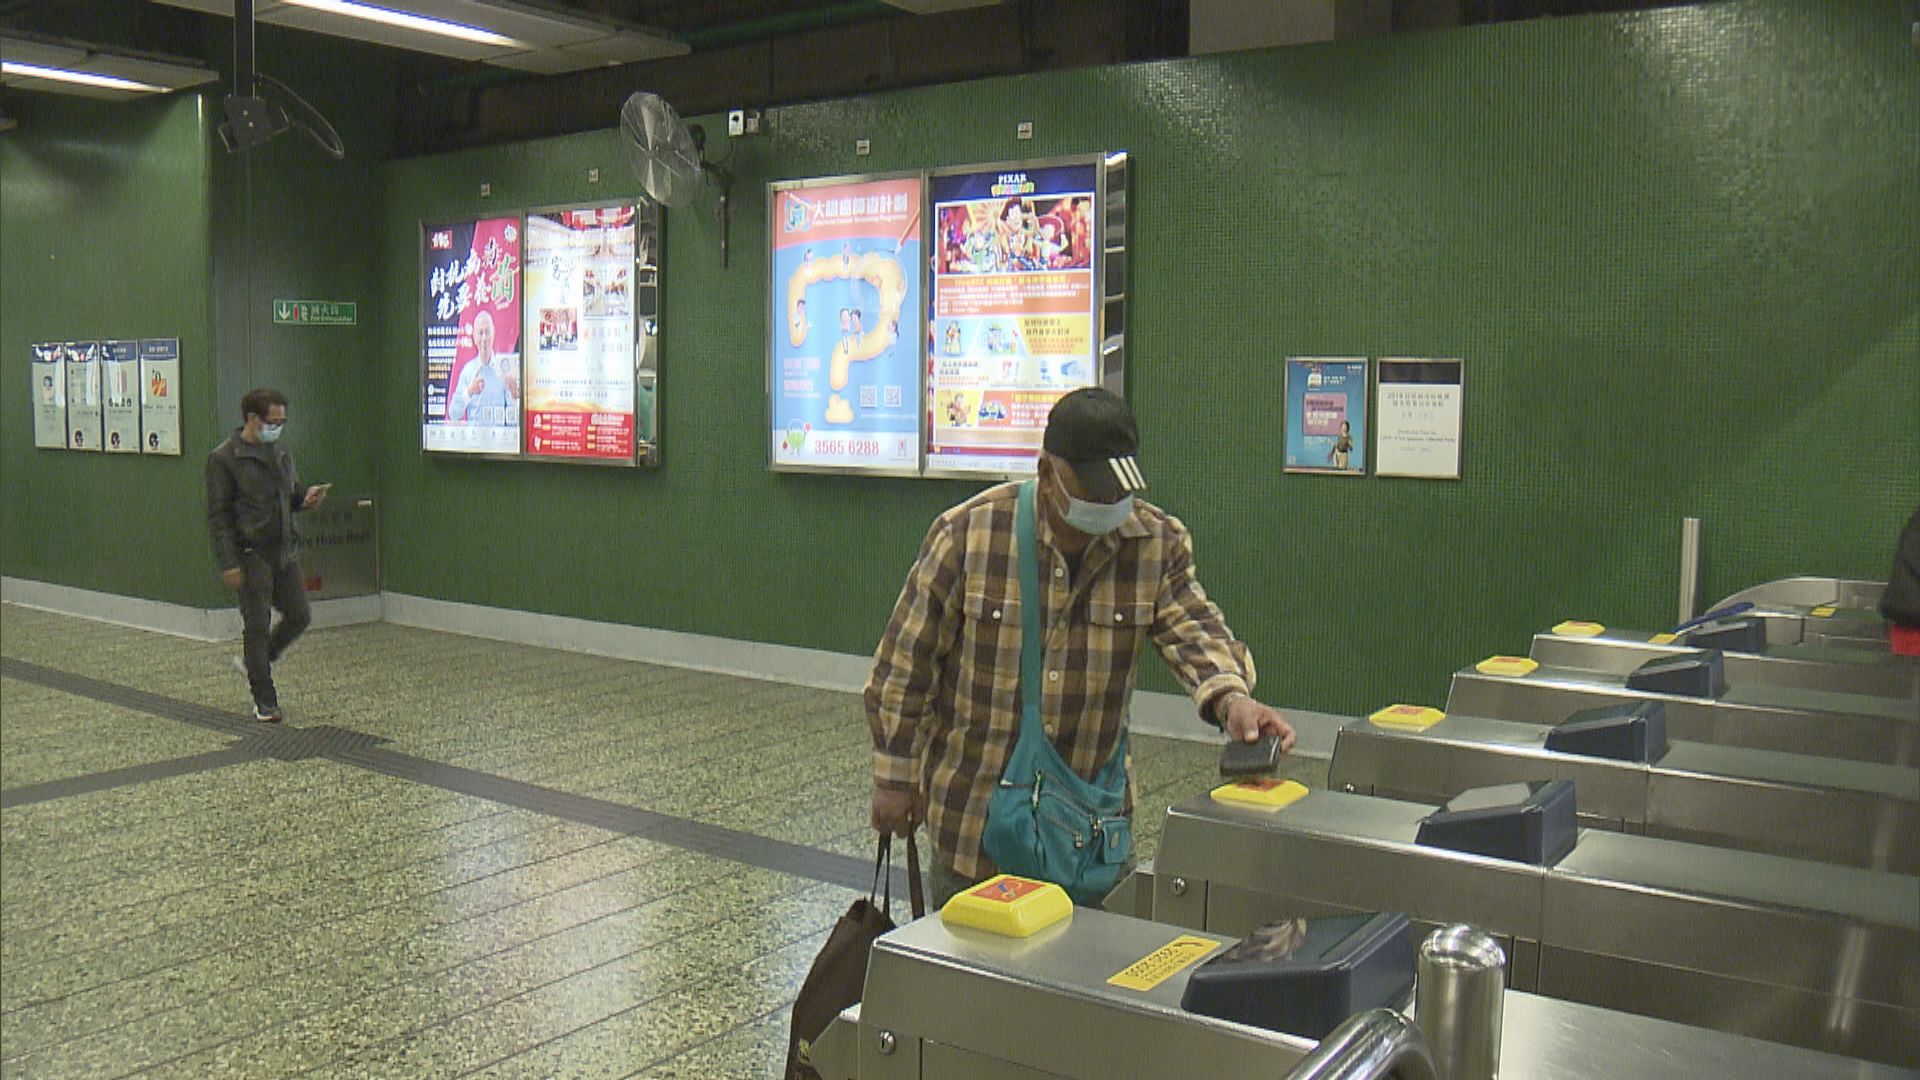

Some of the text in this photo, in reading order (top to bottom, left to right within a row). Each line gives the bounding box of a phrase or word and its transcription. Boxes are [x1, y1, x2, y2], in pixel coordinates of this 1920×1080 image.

[998, 174, 1027, 184] PIXAR
[815, 440, 879, 456] 3565 6288
